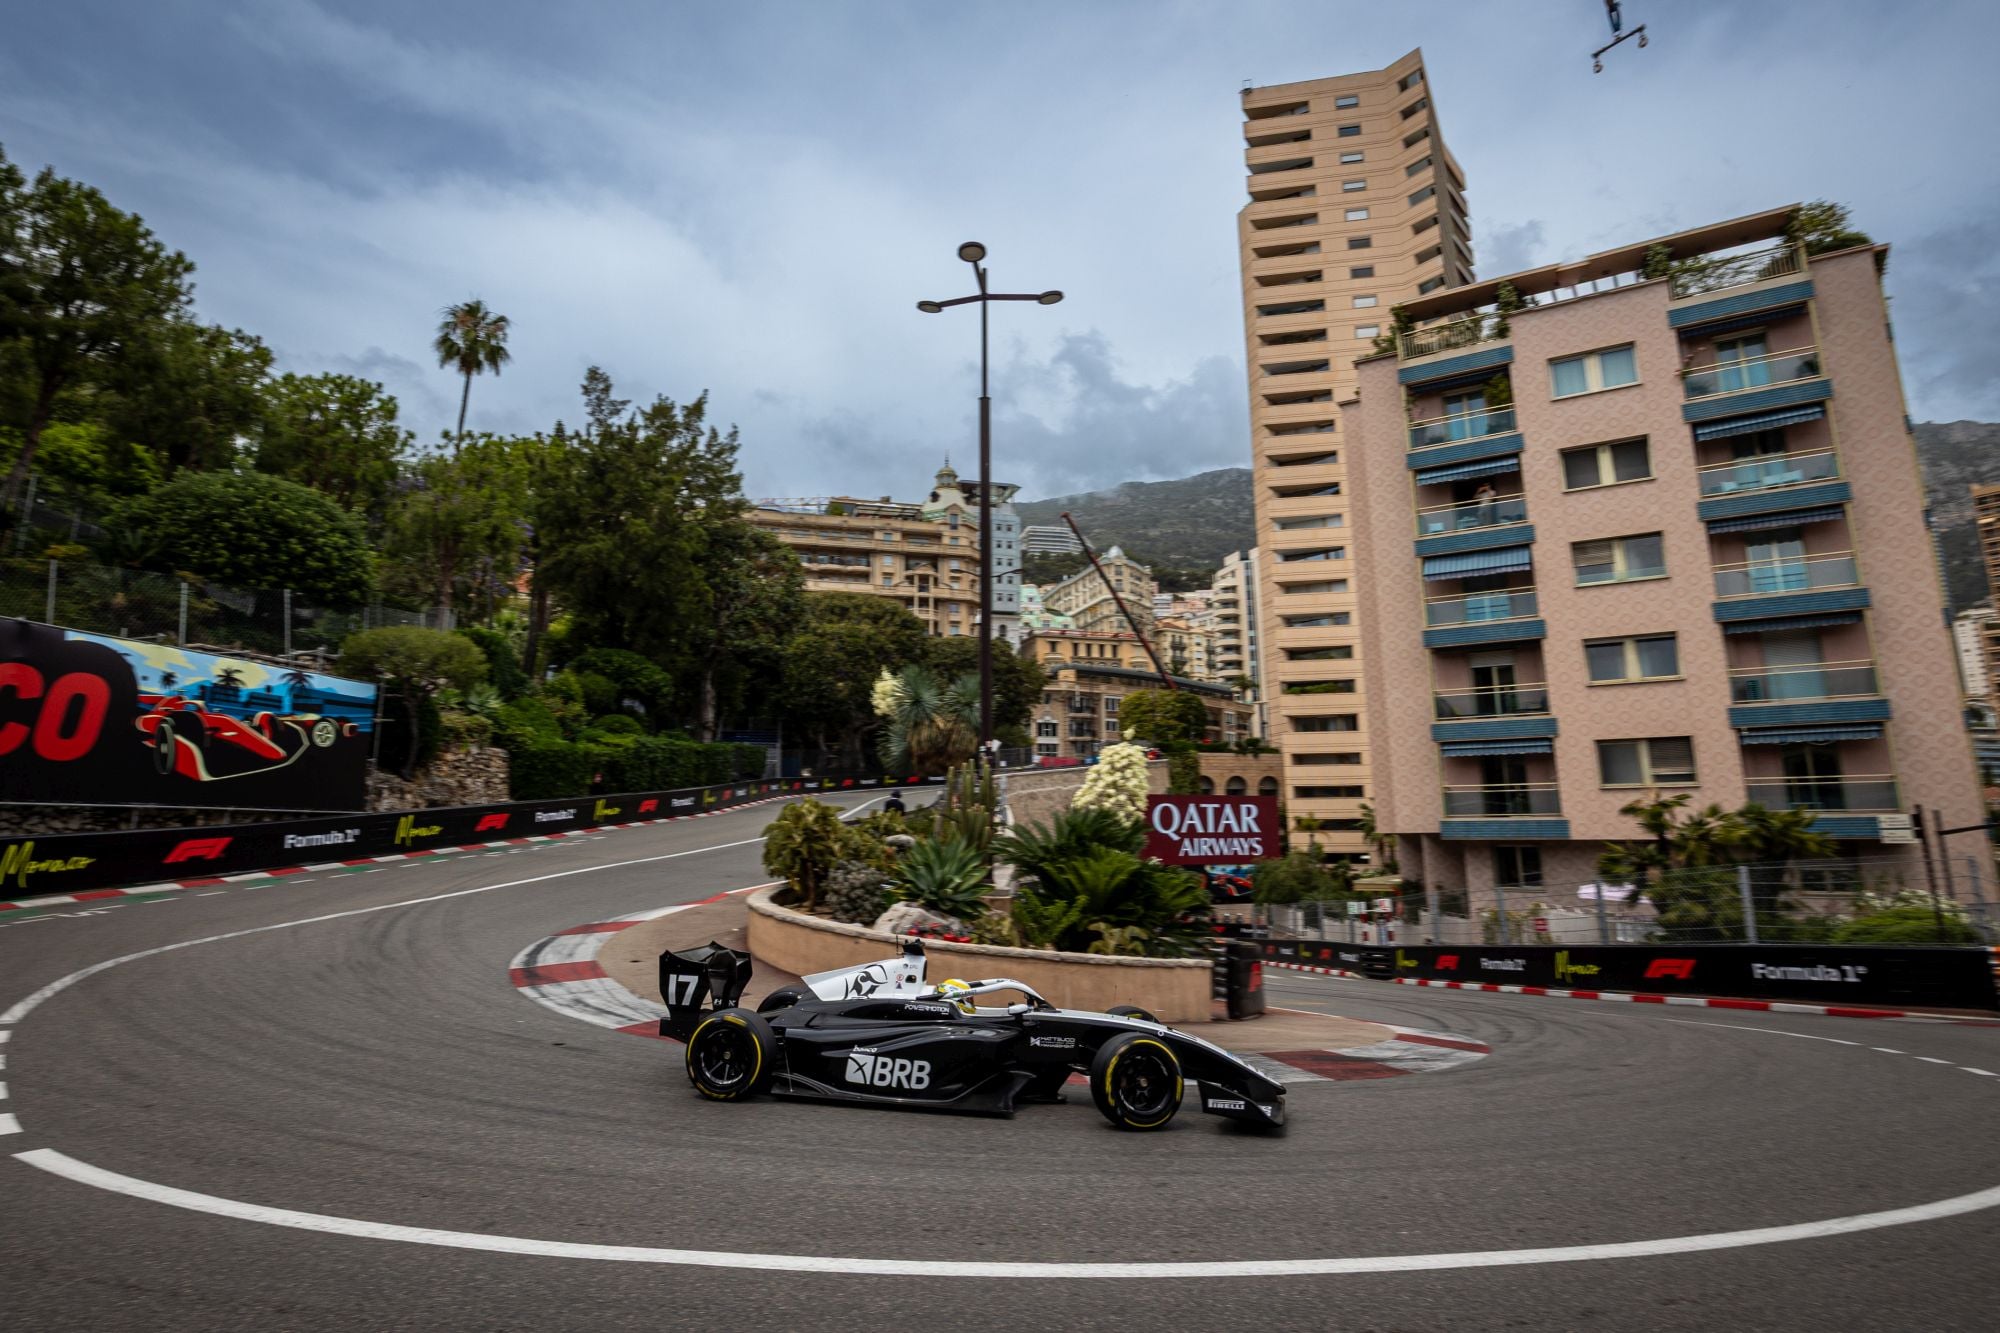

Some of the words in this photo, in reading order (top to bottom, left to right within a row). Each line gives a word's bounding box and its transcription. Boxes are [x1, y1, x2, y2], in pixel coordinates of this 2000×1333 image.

[1152, 802, 1262, 841] QATAR
[284, 831, 344, 848] Formula
[1178, 838, 1263, 857] AIRWAYS
[1751, 963, 1841, 981] Formula
[668, 973, 699, 1006] 17
[873, 1056, 932, 1090] BRB
[1207, 1099, 1245, 1110] PIRELLI
